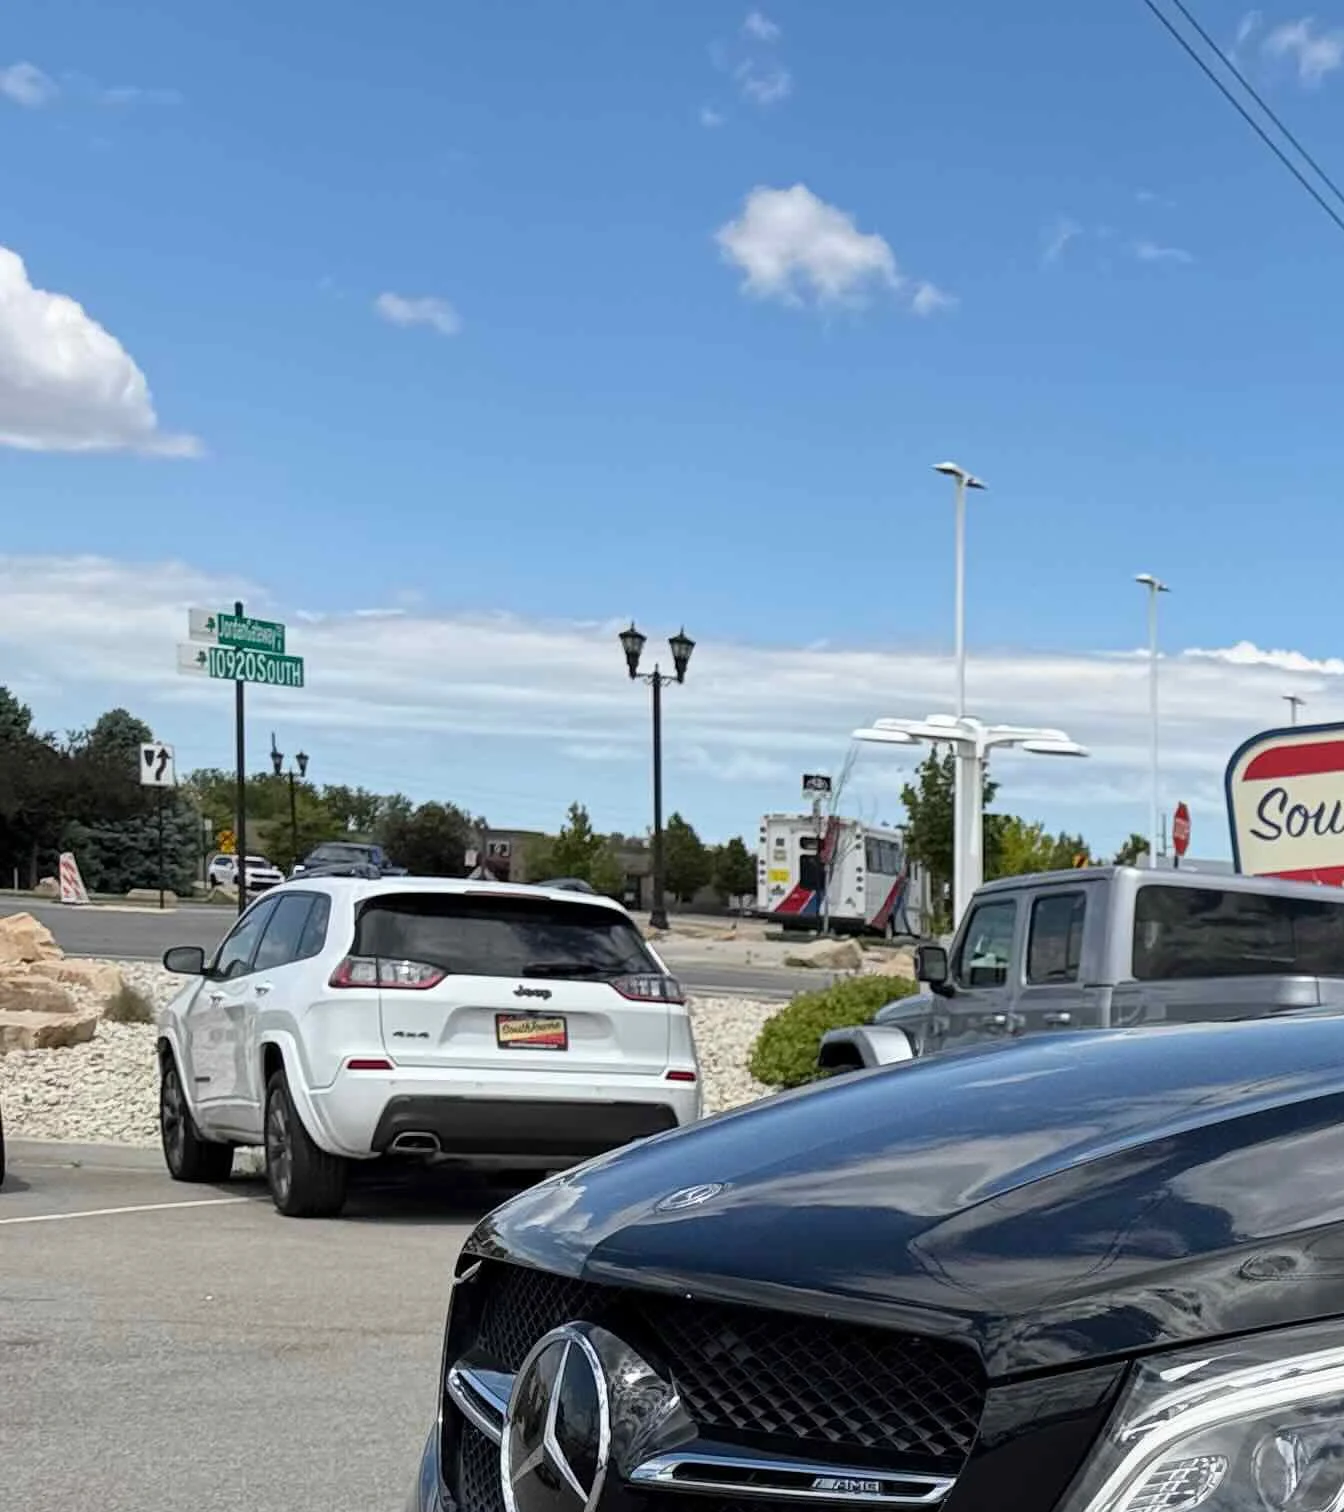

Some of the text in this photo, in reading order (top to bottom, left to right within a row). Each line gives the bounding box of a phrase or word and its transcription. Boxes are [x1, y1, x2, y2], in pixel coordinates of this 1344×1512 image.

[210, 649, 257, 681] 10920
[512, 984, 552, 1000] Jeep
[834, 1479, 880, 1492] AMG
